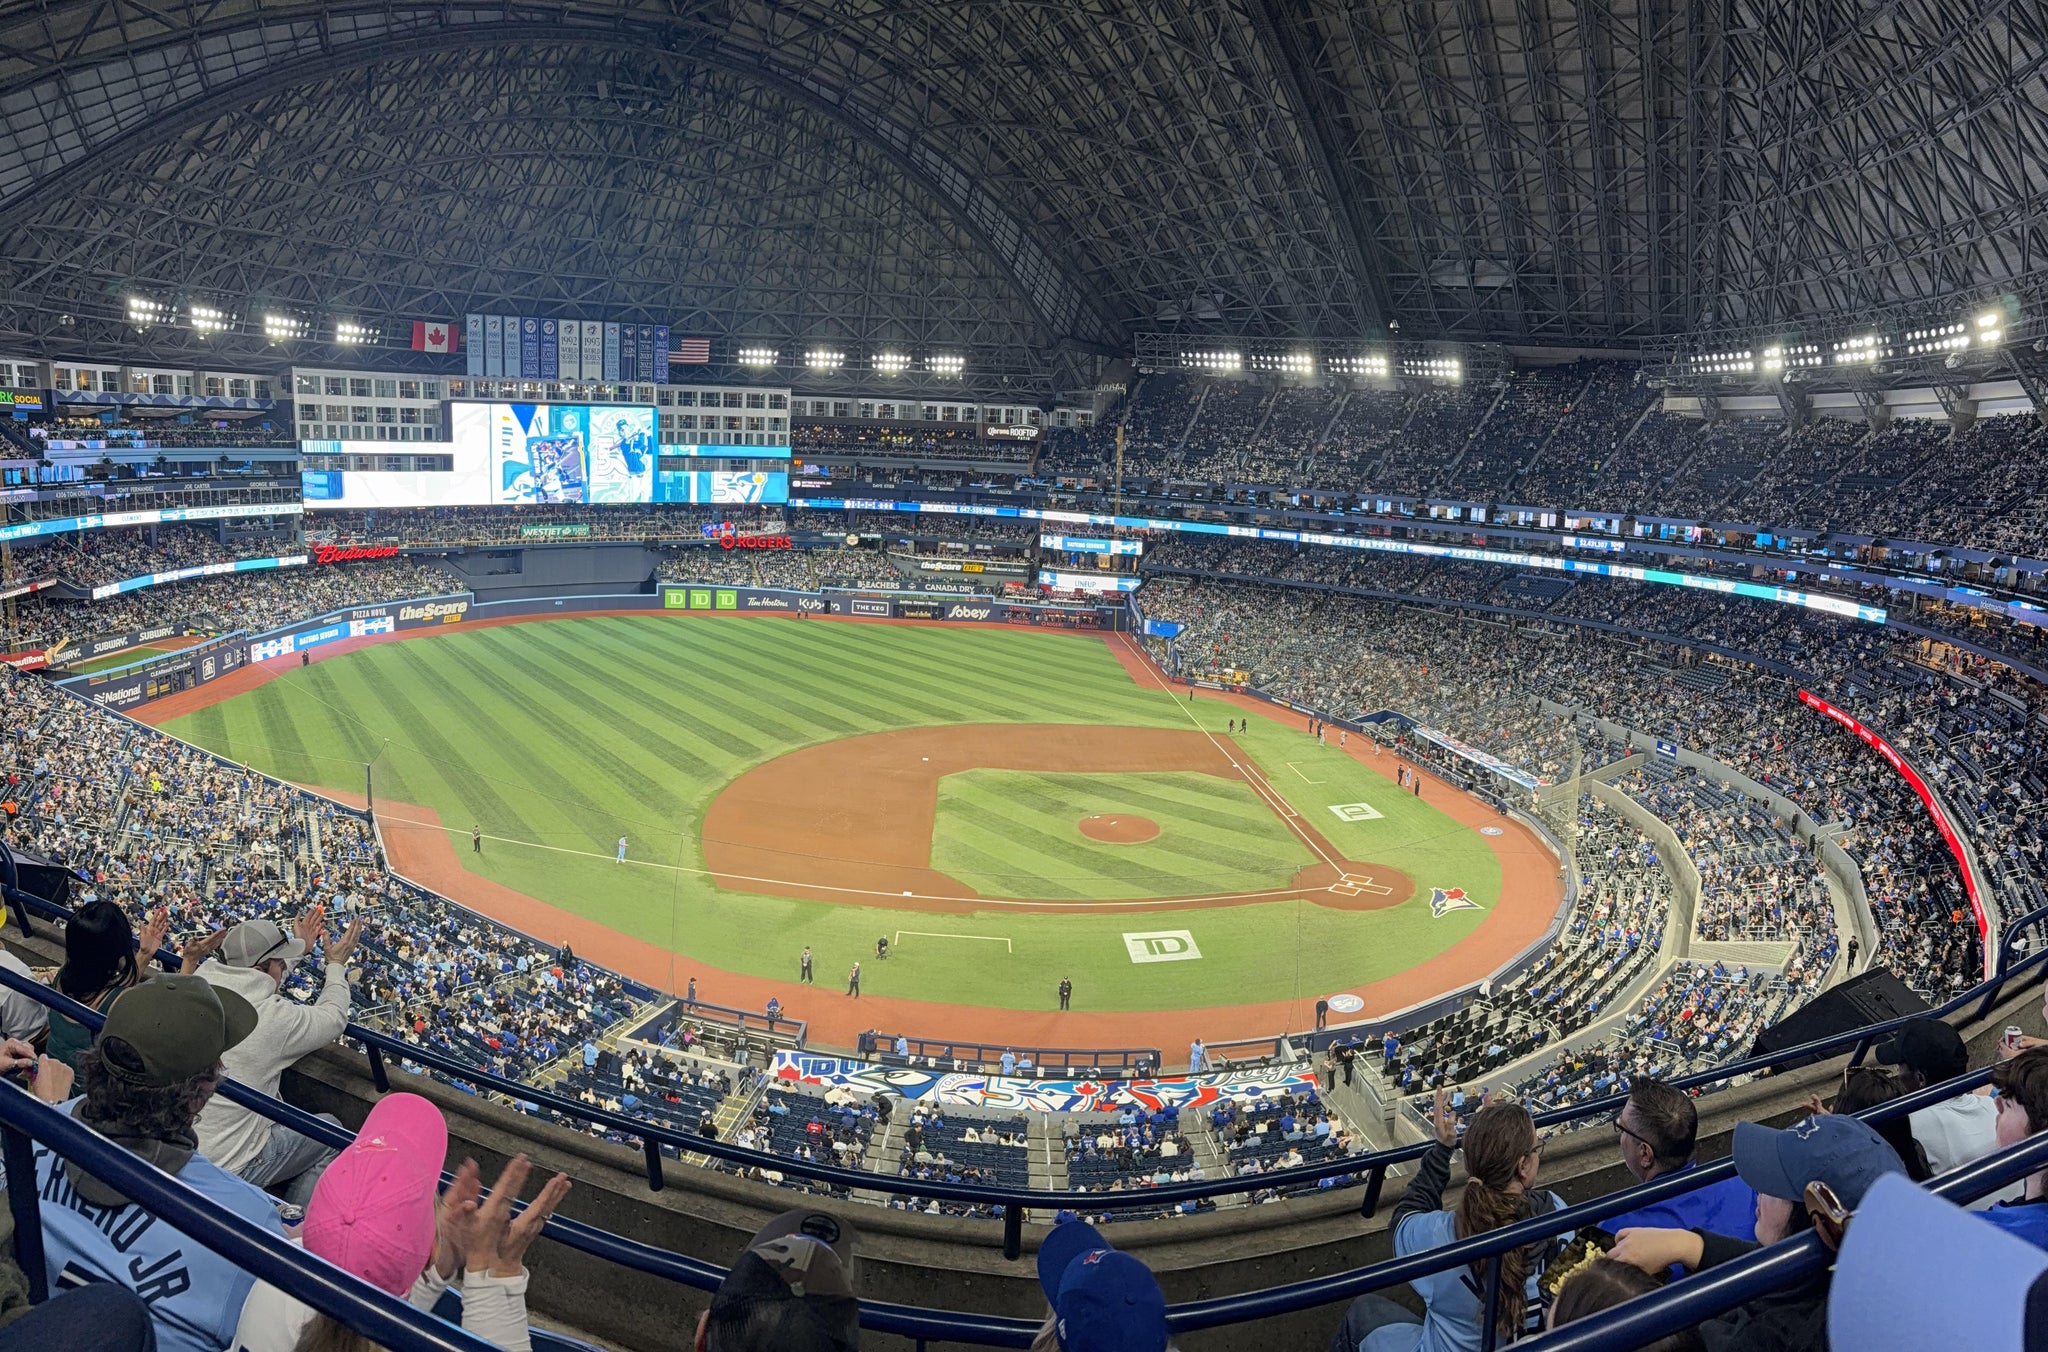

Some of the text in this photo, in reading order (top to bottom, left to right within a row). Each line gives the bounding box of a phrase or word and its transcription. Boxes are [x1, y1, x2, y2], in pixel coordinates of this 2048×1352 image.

[561, 336, 578, 346] 1992
[584, 338, 600, 346] 1993
[14, 396, 42, 404] SOCIAL
[1010, 428, 1038, 437] ROOFTOP
[522, 528, 562, 537] WESTJET
[737, 536, 793, 549] ROGERS
[314, 544, 399, 564] Budweiser
[920, 562, 962, 571] theScore
[857, 580, 975, 594] BLEACHERS CANADA DRY
[1074, 580, 1096, 588] LINEUP
[668, 592, 684, 604] TD
[692, 593, 708, 605] TD
[719, 594, 734, 606] TD
[747, 597, 788, 608] Tim Hortons
[352, 610, 369, 620] PIZZA
[370, 608, 386, 617] NOVA
[400, 602, 468, 620] theScore
[948, 604, 990, 620] Sobeys
[138, 626, 174, 642] SUBWAY
[93, 637, 128, 654] SUBWAY
[105, 684, 142, 703] National
[1132, 936, 1189, 956] TD
[942, 1072, 986, 1089] TORONTO
[128, 1249, 192, 1306] JR
